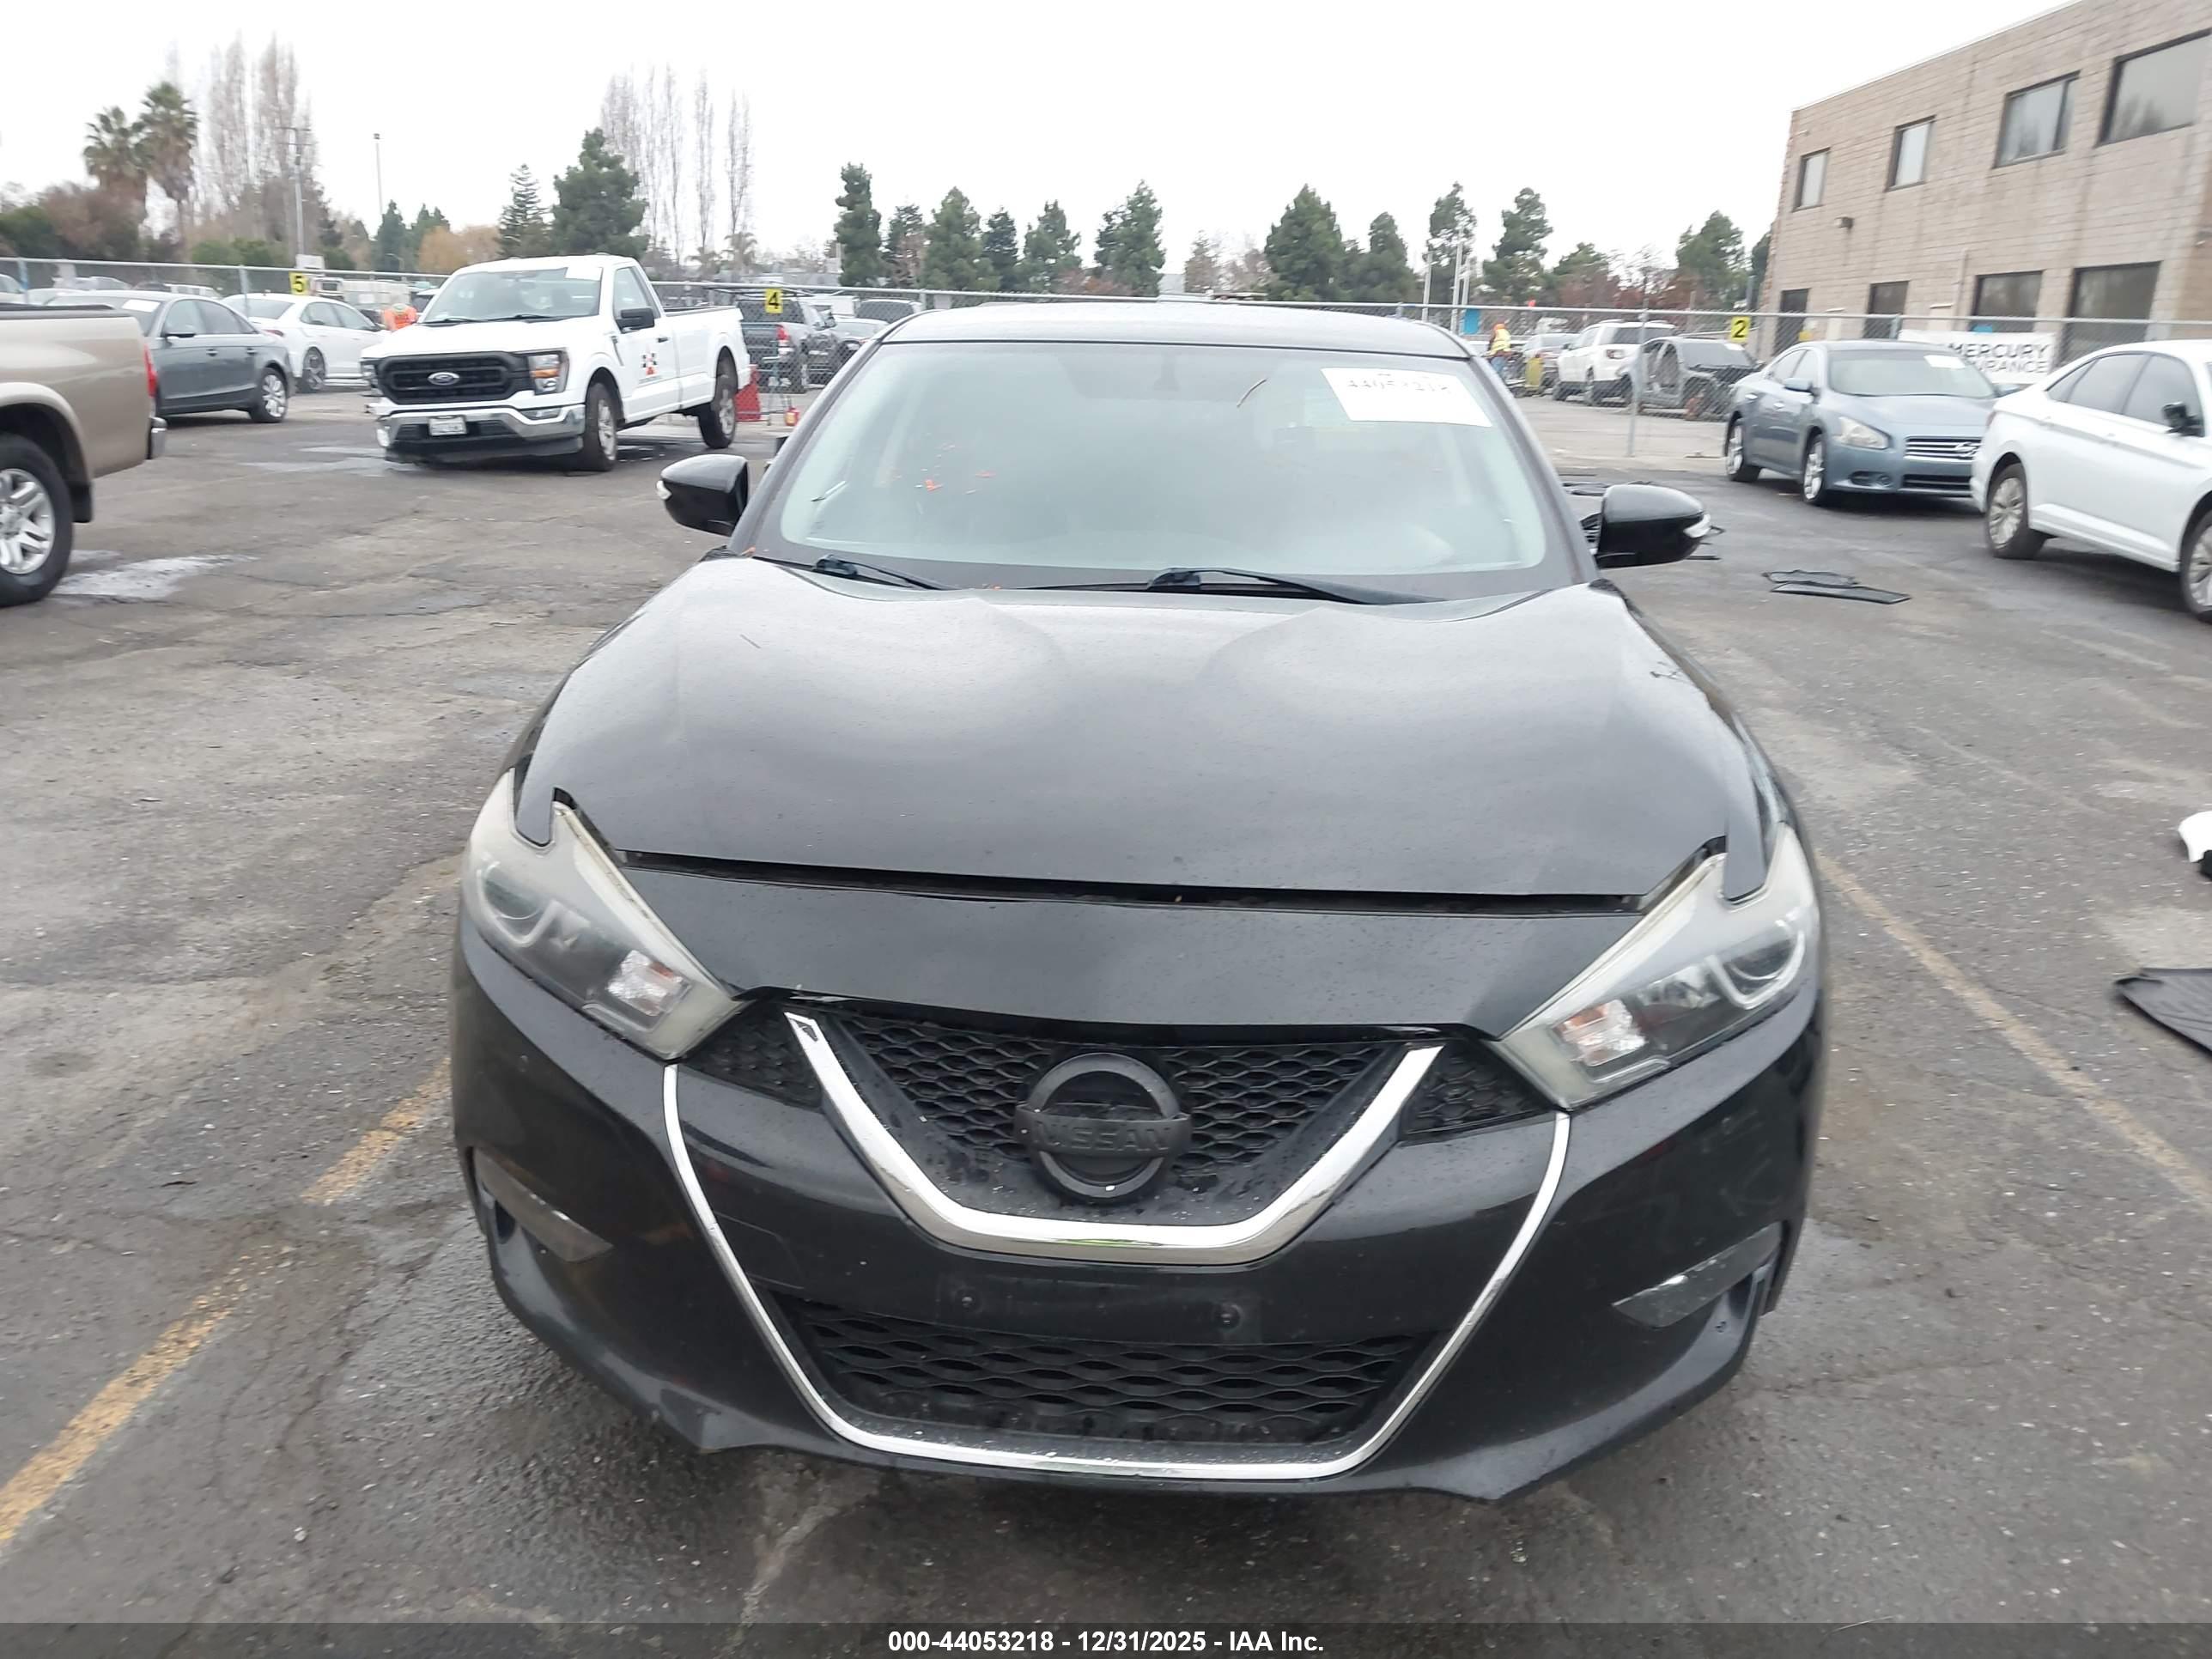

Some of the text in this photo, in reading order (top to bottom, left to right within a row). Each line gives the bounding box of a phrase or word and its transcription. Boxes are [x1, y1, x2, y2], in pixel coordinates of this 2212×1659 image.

[294, 275, 305, 293] 5
[768, 291, 780, 310] 4
[1733, 319, 1747, 338] 2
